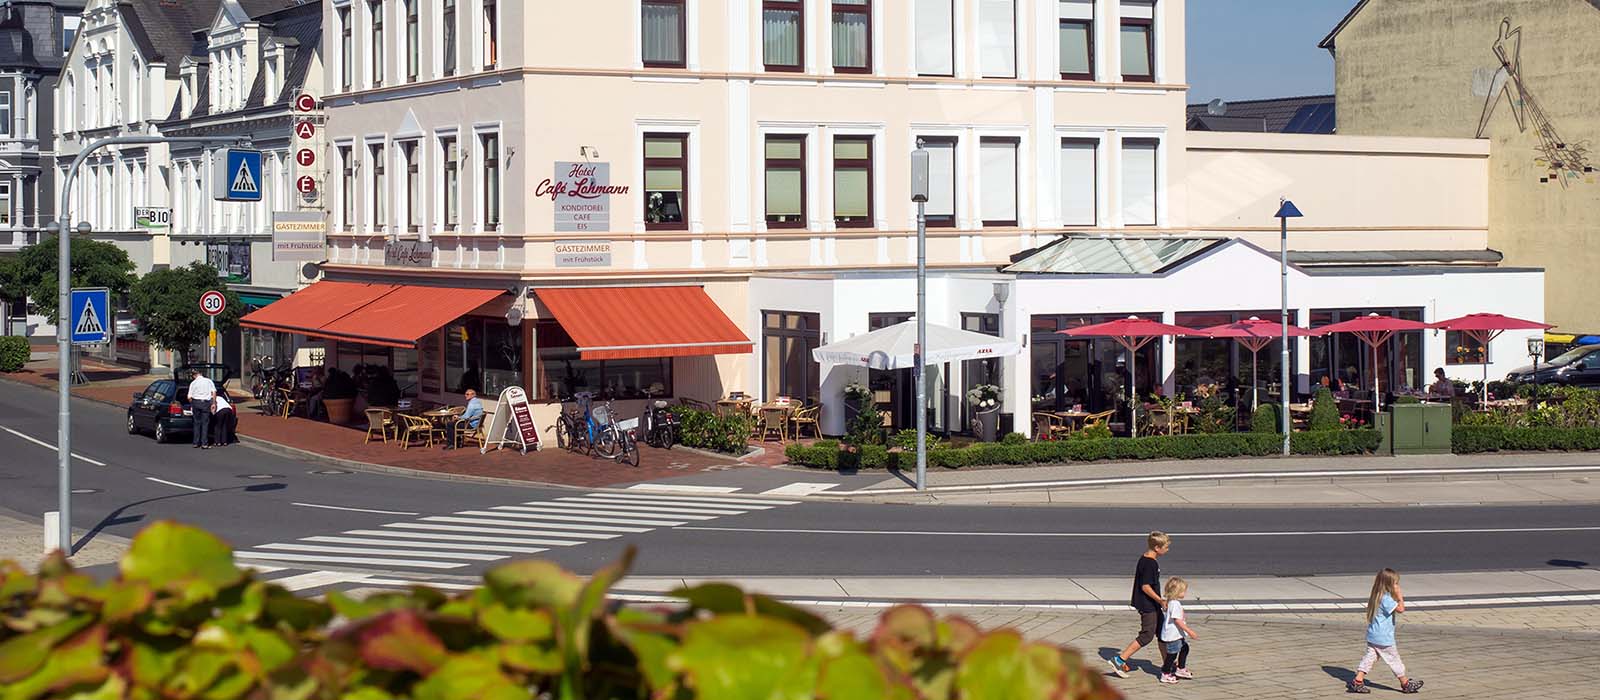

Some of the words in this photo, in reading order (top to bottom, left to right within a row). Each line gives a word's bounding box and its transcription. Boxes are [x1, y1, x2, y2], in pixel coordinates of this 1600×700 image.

[299, 96, 313, 193] CAFÉ
[568, 163, 597, 178] Hotel
[535, 178, 568, 201] Café
[568, 178, 629, 199] Lohmann
[561, 204, 604, 212] KONDITOREI
[150, 210, 168, 223] BIO
[577, 222, 588, 230] EIS
[206, 298, 220, 309] 30
